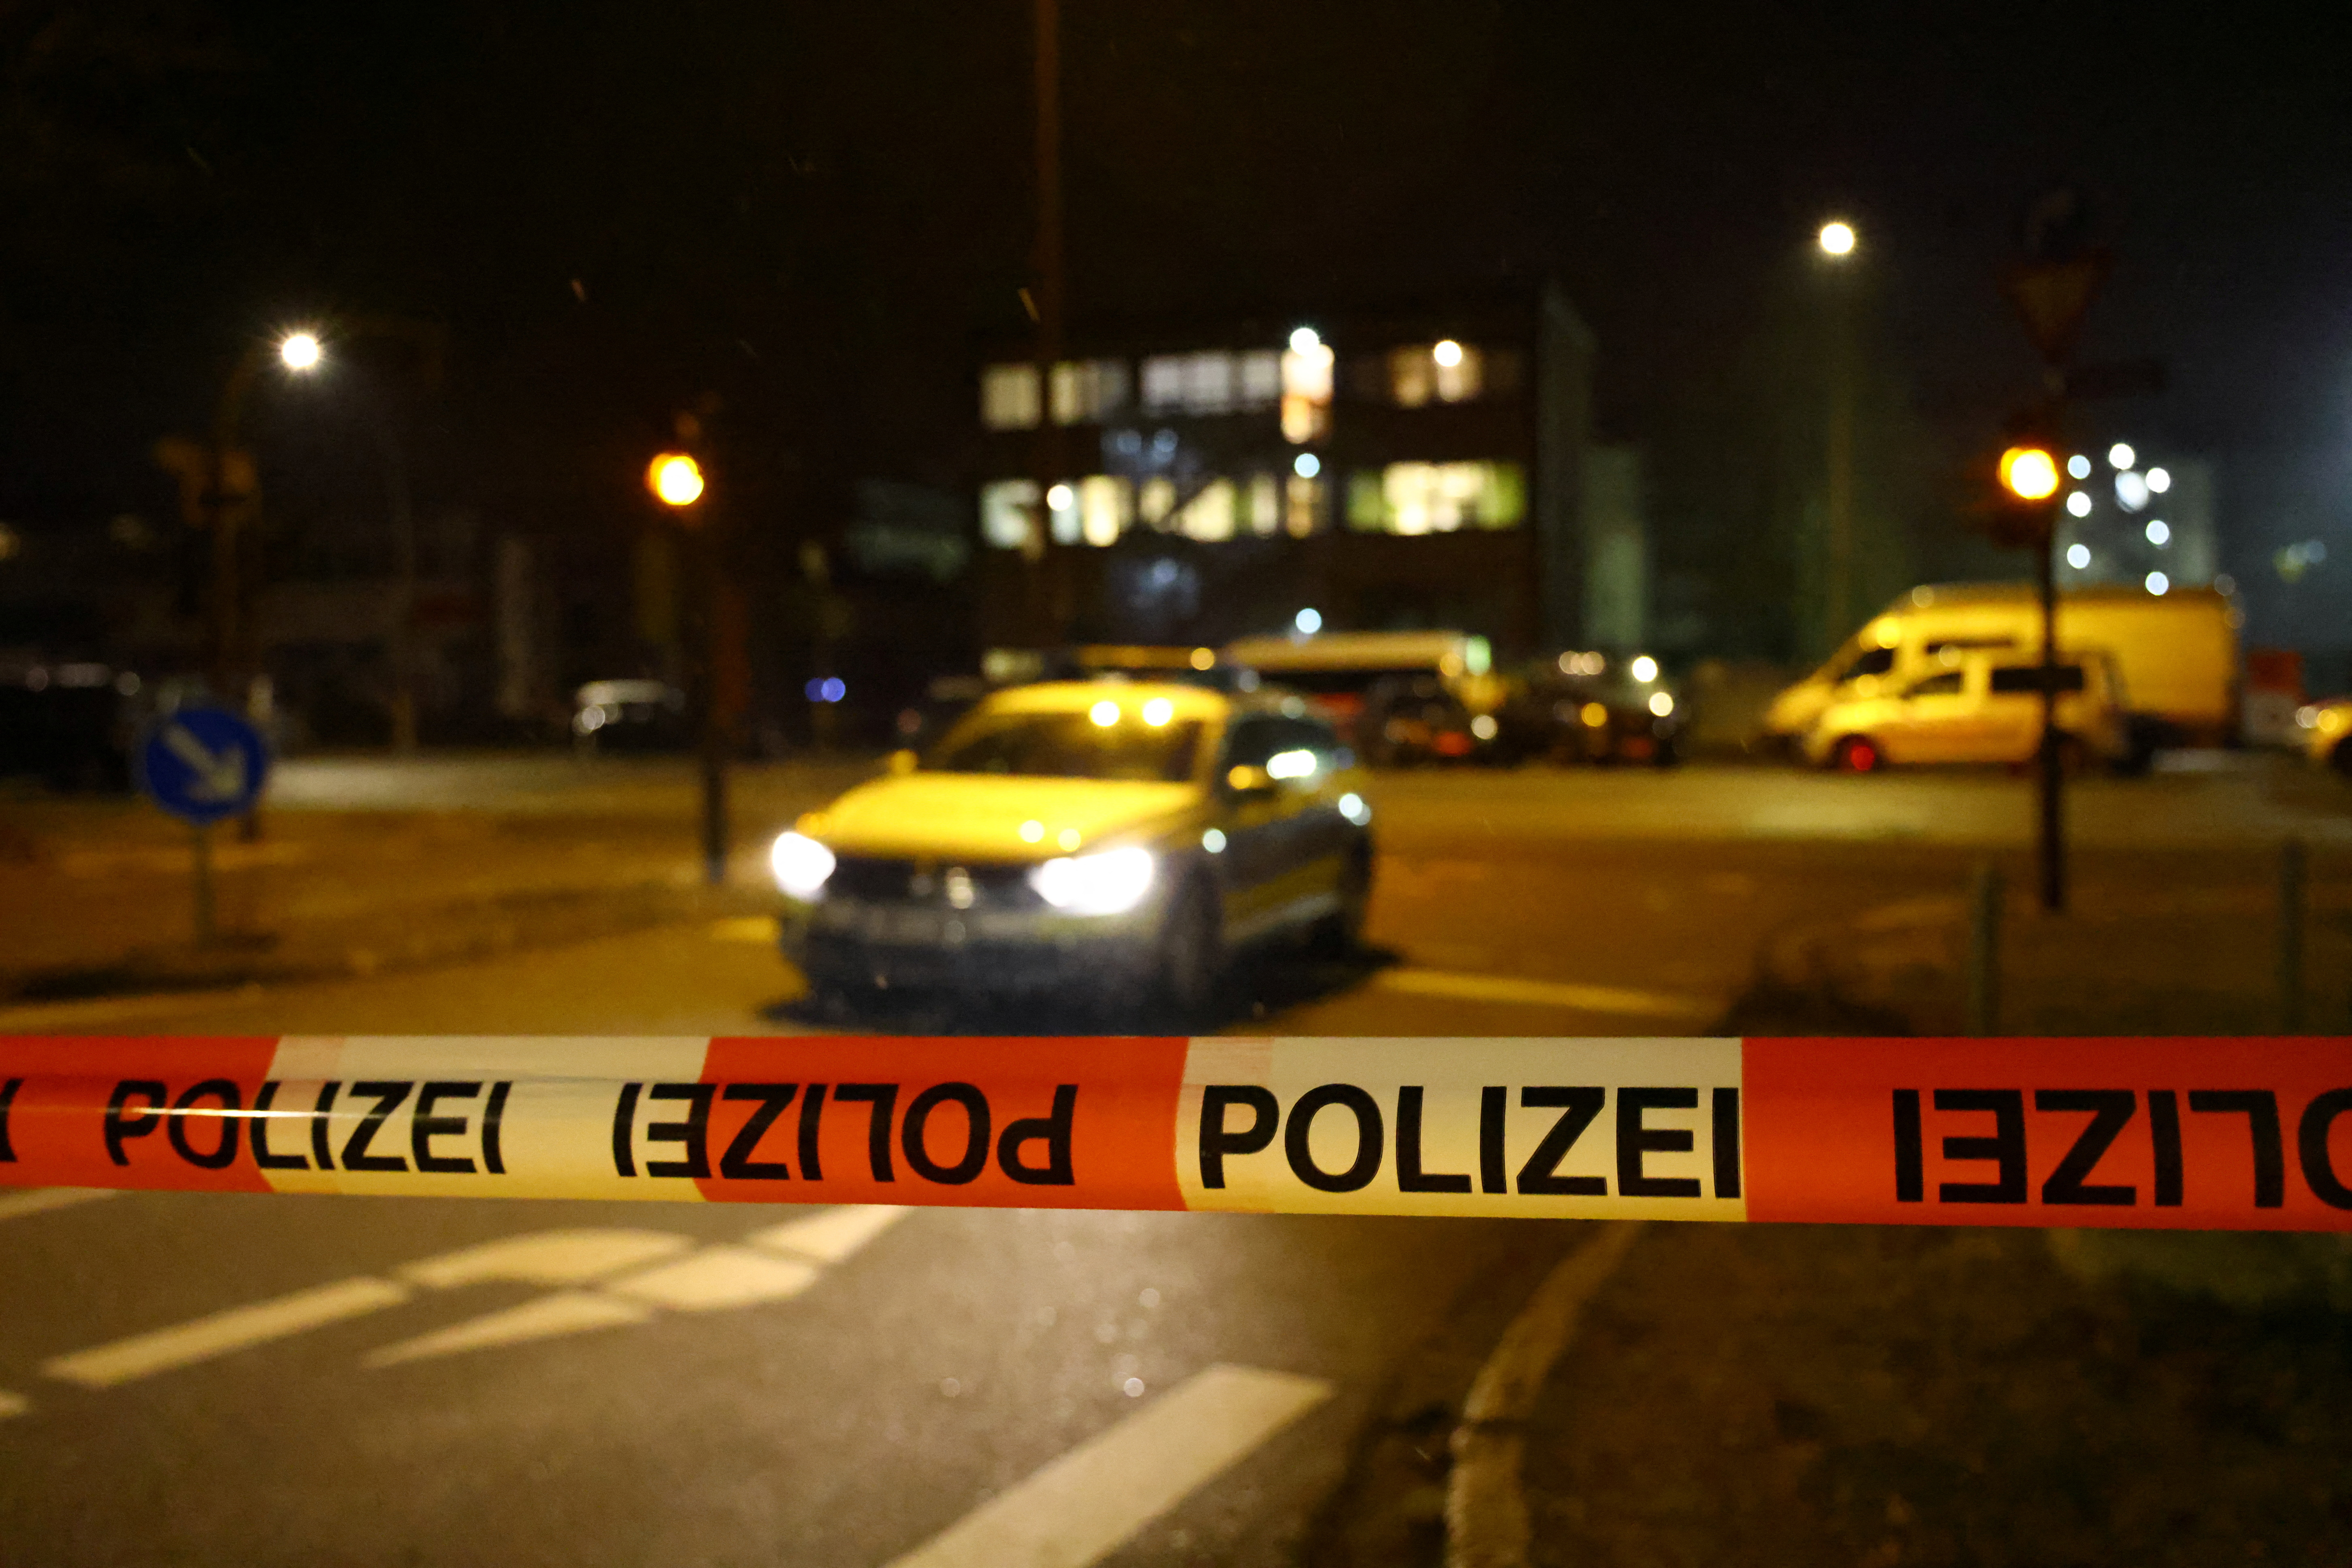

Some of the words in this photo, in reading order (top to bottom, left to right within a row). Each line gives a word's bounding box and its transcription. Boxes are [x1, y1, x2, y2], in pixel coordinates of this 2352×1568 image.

[104, 1079, 511, 1173] POLIZEI
[613, 1082, 1077, 1185] POLIZEI
[1200, 1084, 1740, 1198] POLIZEI
[1893, 1087, 2352, 1210] OLIZEI
